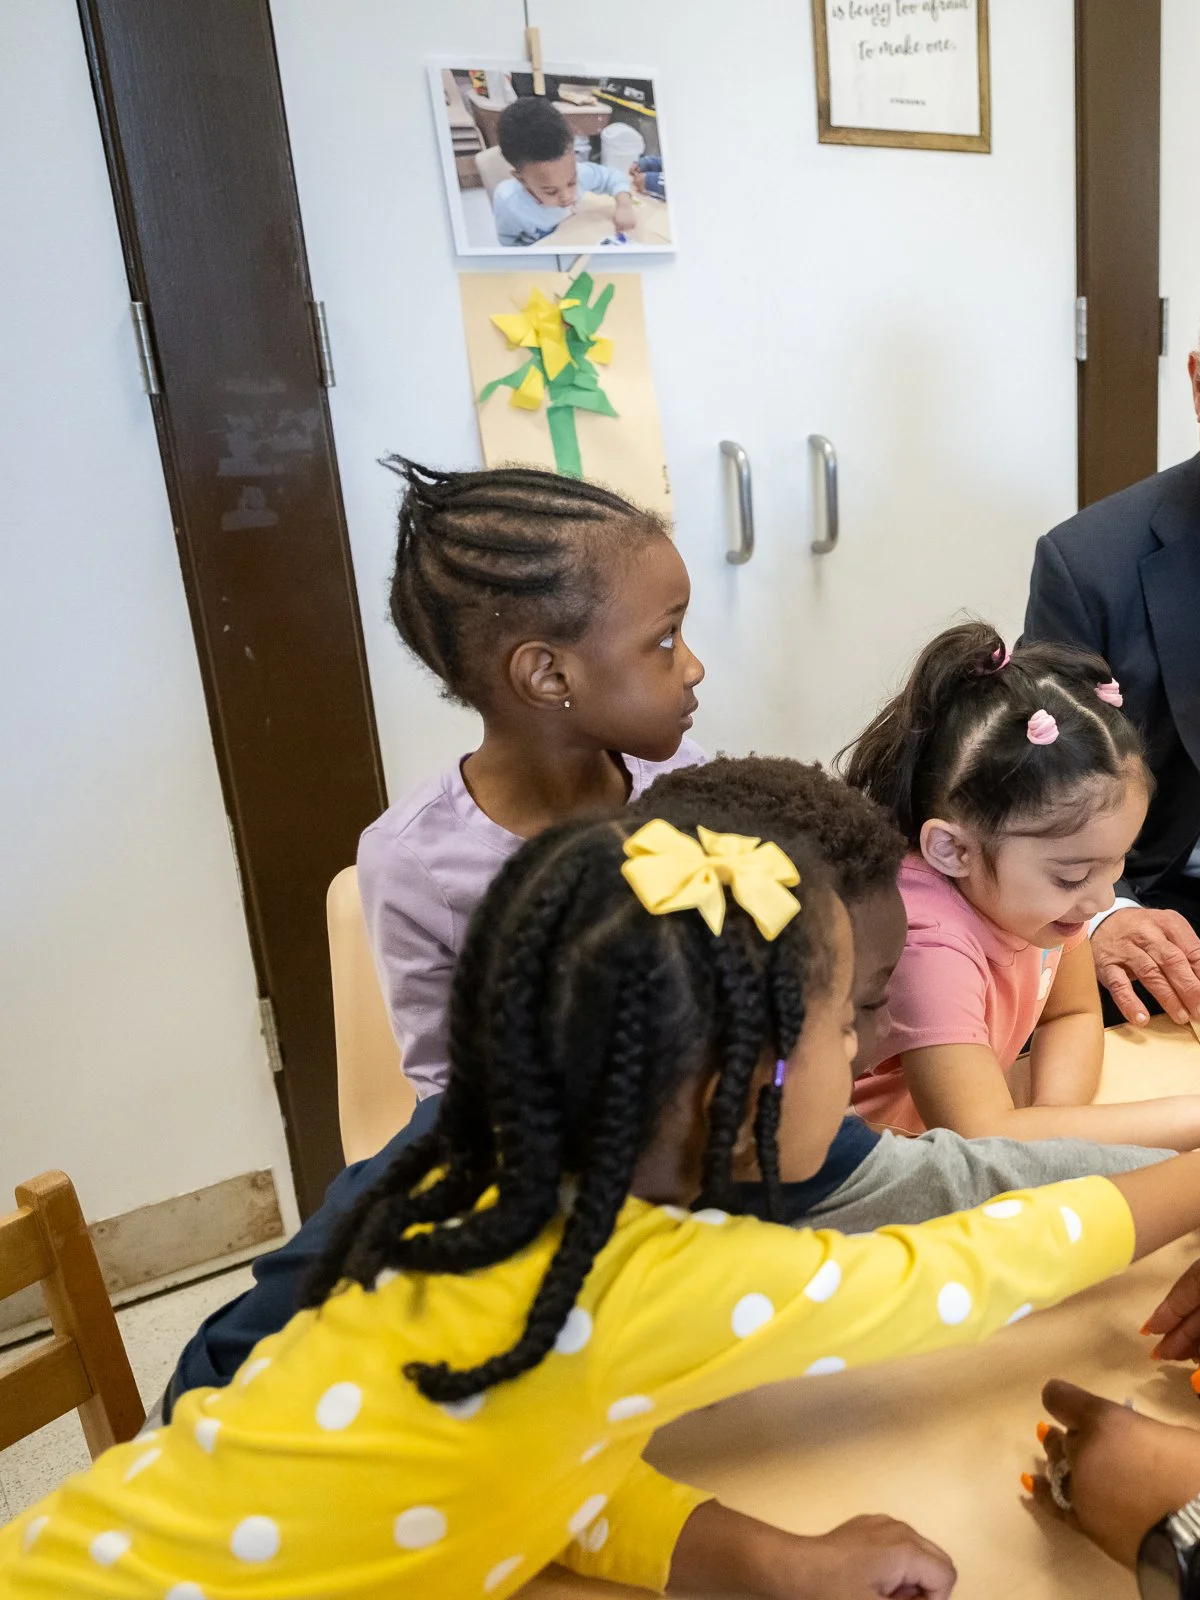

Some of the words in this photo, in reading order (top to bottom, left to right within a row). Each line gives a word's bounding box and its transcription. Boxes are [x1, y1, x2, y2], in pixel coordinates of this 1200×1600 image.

[832, 4, 845, 20] is
[849, 0, 891, 27] being
[879, 34, 920, 56] make
